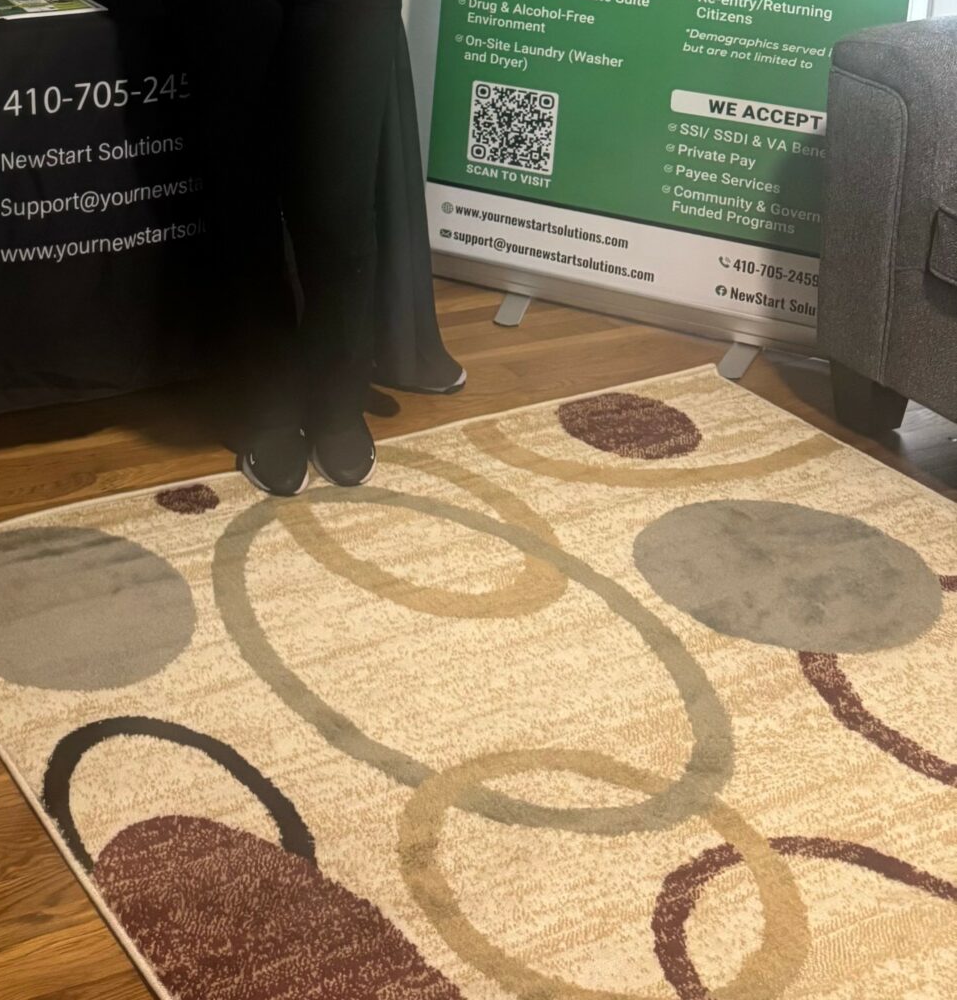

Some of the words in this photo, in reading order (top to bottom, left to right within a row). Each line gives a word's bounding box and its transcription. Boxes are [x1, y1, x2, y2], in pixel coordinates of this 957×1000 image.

[467, 12, 546, 34] Environment
[500, 1, 510, 13] &
[512, 4, 595, 24] Alcohol-Free
[696, 6, 753, 25] Citizens
[464, 51, 487, 64] and
[490, 53, 528, 72] Dryer)
[465, 34, 511, 52] On-Site
[514, 41, 566, 62] Laundry
[568, 49, 624, 68] (Washer
[682, 42, 704, 54] but
[706, 48, 728, 58] are
[730, 50, 752, 61] not
[754, 52, 797, 68] limited
[800, 59, 813, 70] to
[782, 42, 826, 57] served
[708, 98, 737, 117] WE
[742, 105, 823, 130] ACCEPT
[680, 123, 710, 140] SSI/
[714, 128, 748, 145] SSDI
[752, 136, 762, 148] &
[766, 137, 788, 152] VA
[1, 144, 92, 172] NewStart
[98, 136, 184, 162] Solutions
[678, 144, 726, 162] Private
[730, 154, 756, 171] Pay
[466, 164, 498, 179] SCAN
[502, 170, 518, 182] TO
[520, 174, 552, 188] VISIT
[676, 164, 718, 182] Payee
[721, 172, 780, 194] Services
[674, 186, 753, 212] Community
[756, 200, 766, 212] &
[456, 204, 628, 249] www.yournewstartsolutions.com
[672, 201, 722, 220] Funded
[726, 211, 795, 234] Programs
[453, 228, 654, 283] support@yournewstartsolutions.com
[730, 286, 785, 311] NewStart
[789, 301, 816, 317] Solu
